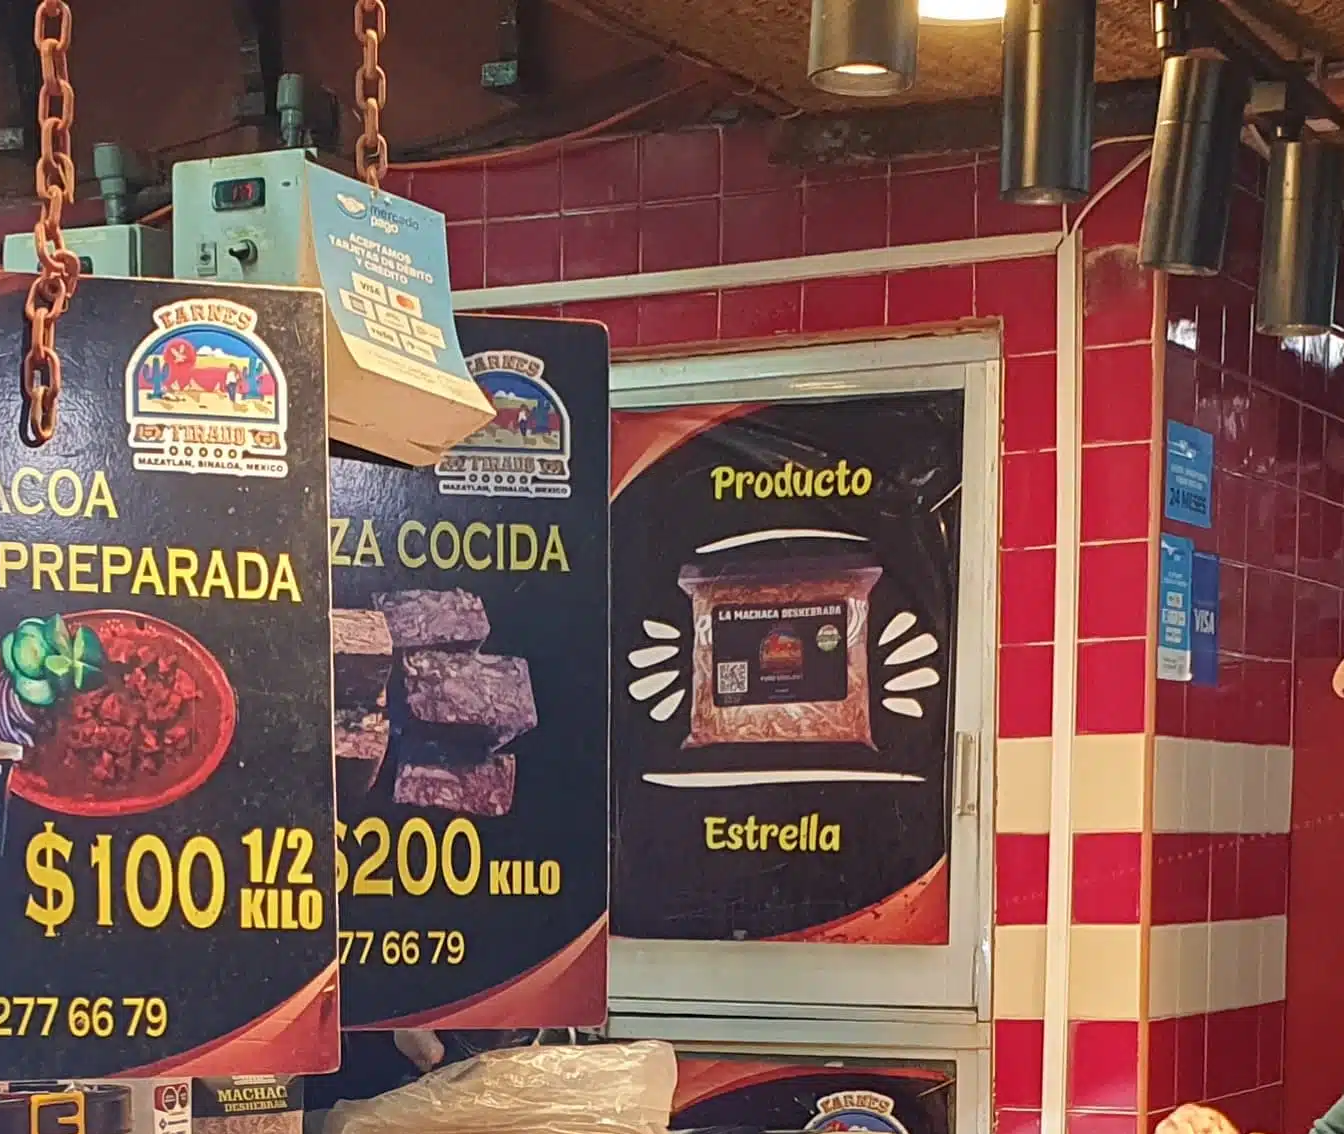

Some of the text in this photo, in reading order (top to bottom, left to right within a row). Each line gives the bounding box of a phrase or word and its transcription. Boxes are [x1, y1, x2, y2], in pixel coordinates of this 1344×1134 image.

[370, 204, 419, 232] mercado
[370, 215, 399, 234] pago
[328, 234, 379, 265] TARJETAS
[349, 232, 412, 265] ACEPTAMOS
[359, 281, 382, 296] VISA
[159, 303, 253, 331] CARNES
[709, 460, 873, 501] Producto
[397, 519, 571, 573] COCIDA
[718, 609, 732, 622] LA
[733, 608, 780, 621] MACHACA
[1194, 608, 1215, 635] VISA
[704, 813, 842, 853] Estrella
[240, 826, 314, 885] 1/2
[24, 820, 226, 937] $100
[488, 859, 561, 896] KILO
[239, 887, 324, 931] KILO
[382, 930, 420, 965] 66
[428, 930, 466, 966] 79
[67, 996, 114, 1038] 66
[121, 996, 168, 1038] 79
